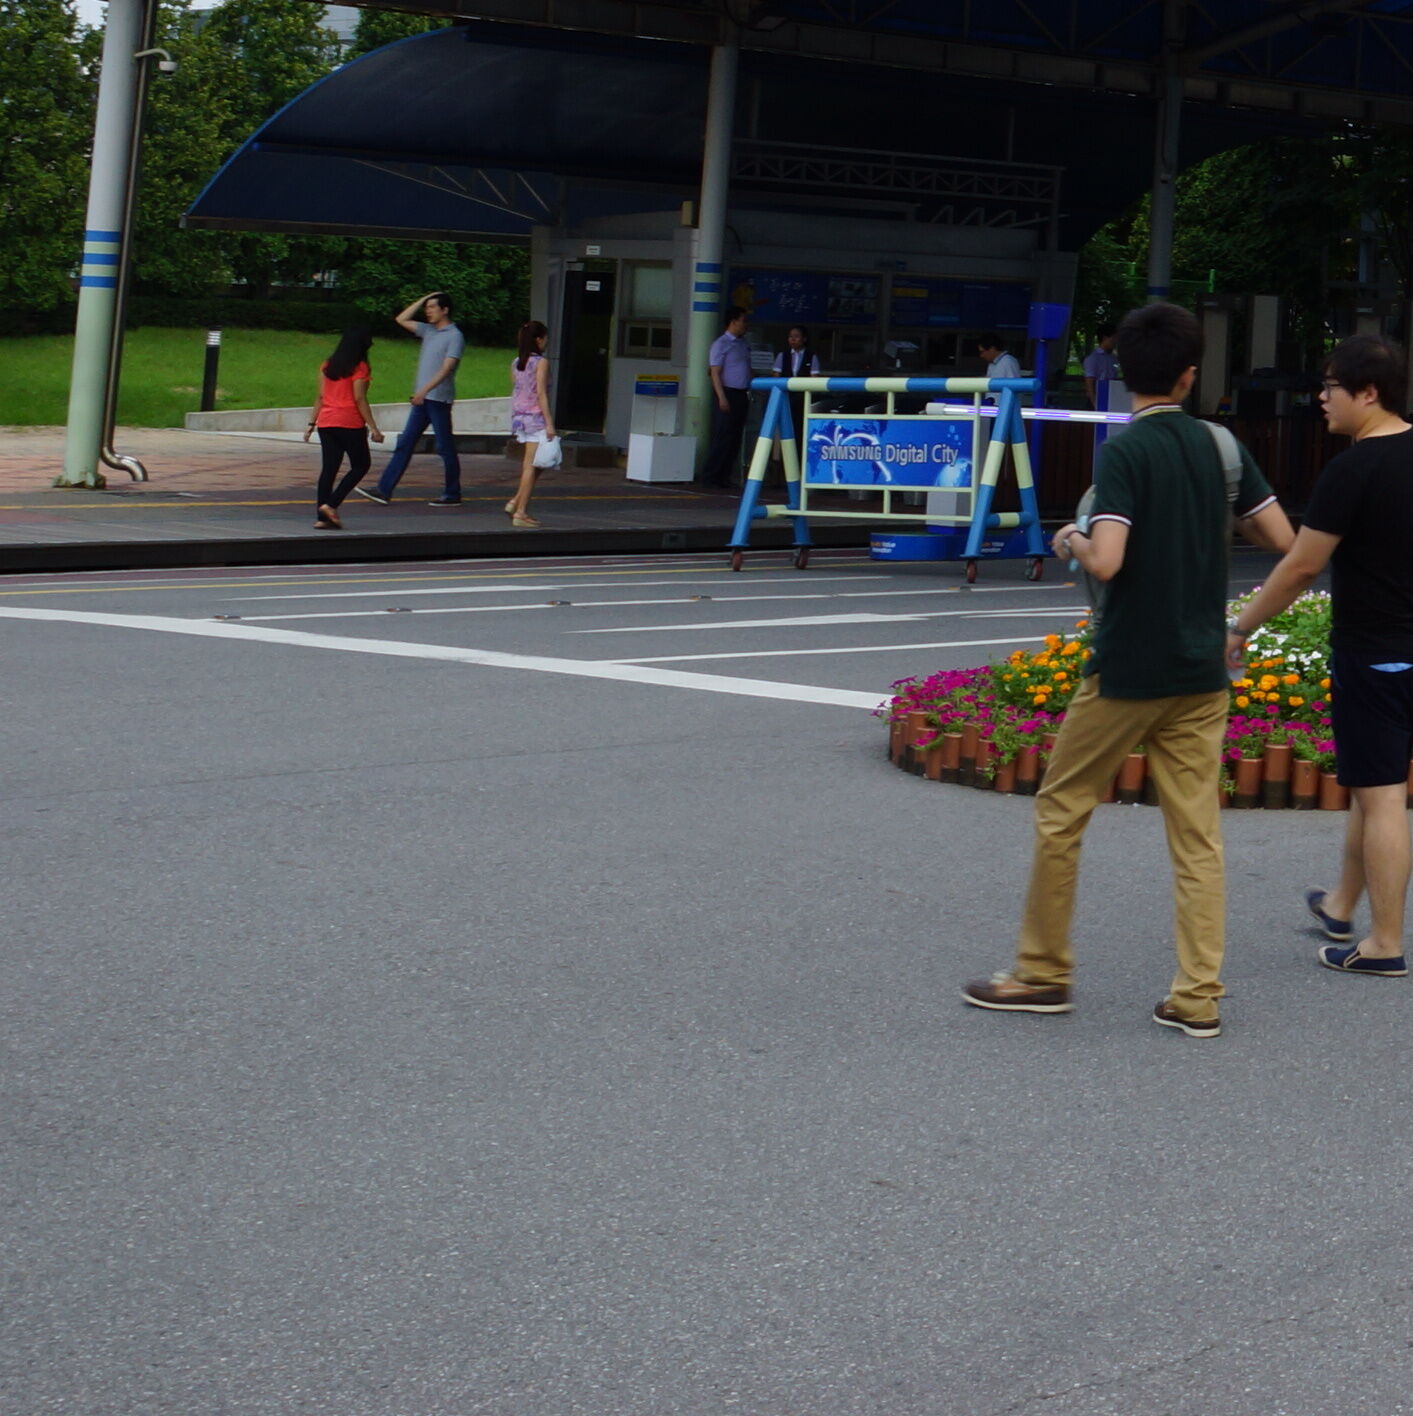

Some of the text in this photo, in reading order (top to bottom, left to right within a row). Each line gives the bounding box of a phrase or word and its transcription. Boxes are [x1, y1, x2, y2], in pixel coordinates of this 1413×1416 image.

[821, 444, 959, 466] SAMSUNG Digital City
